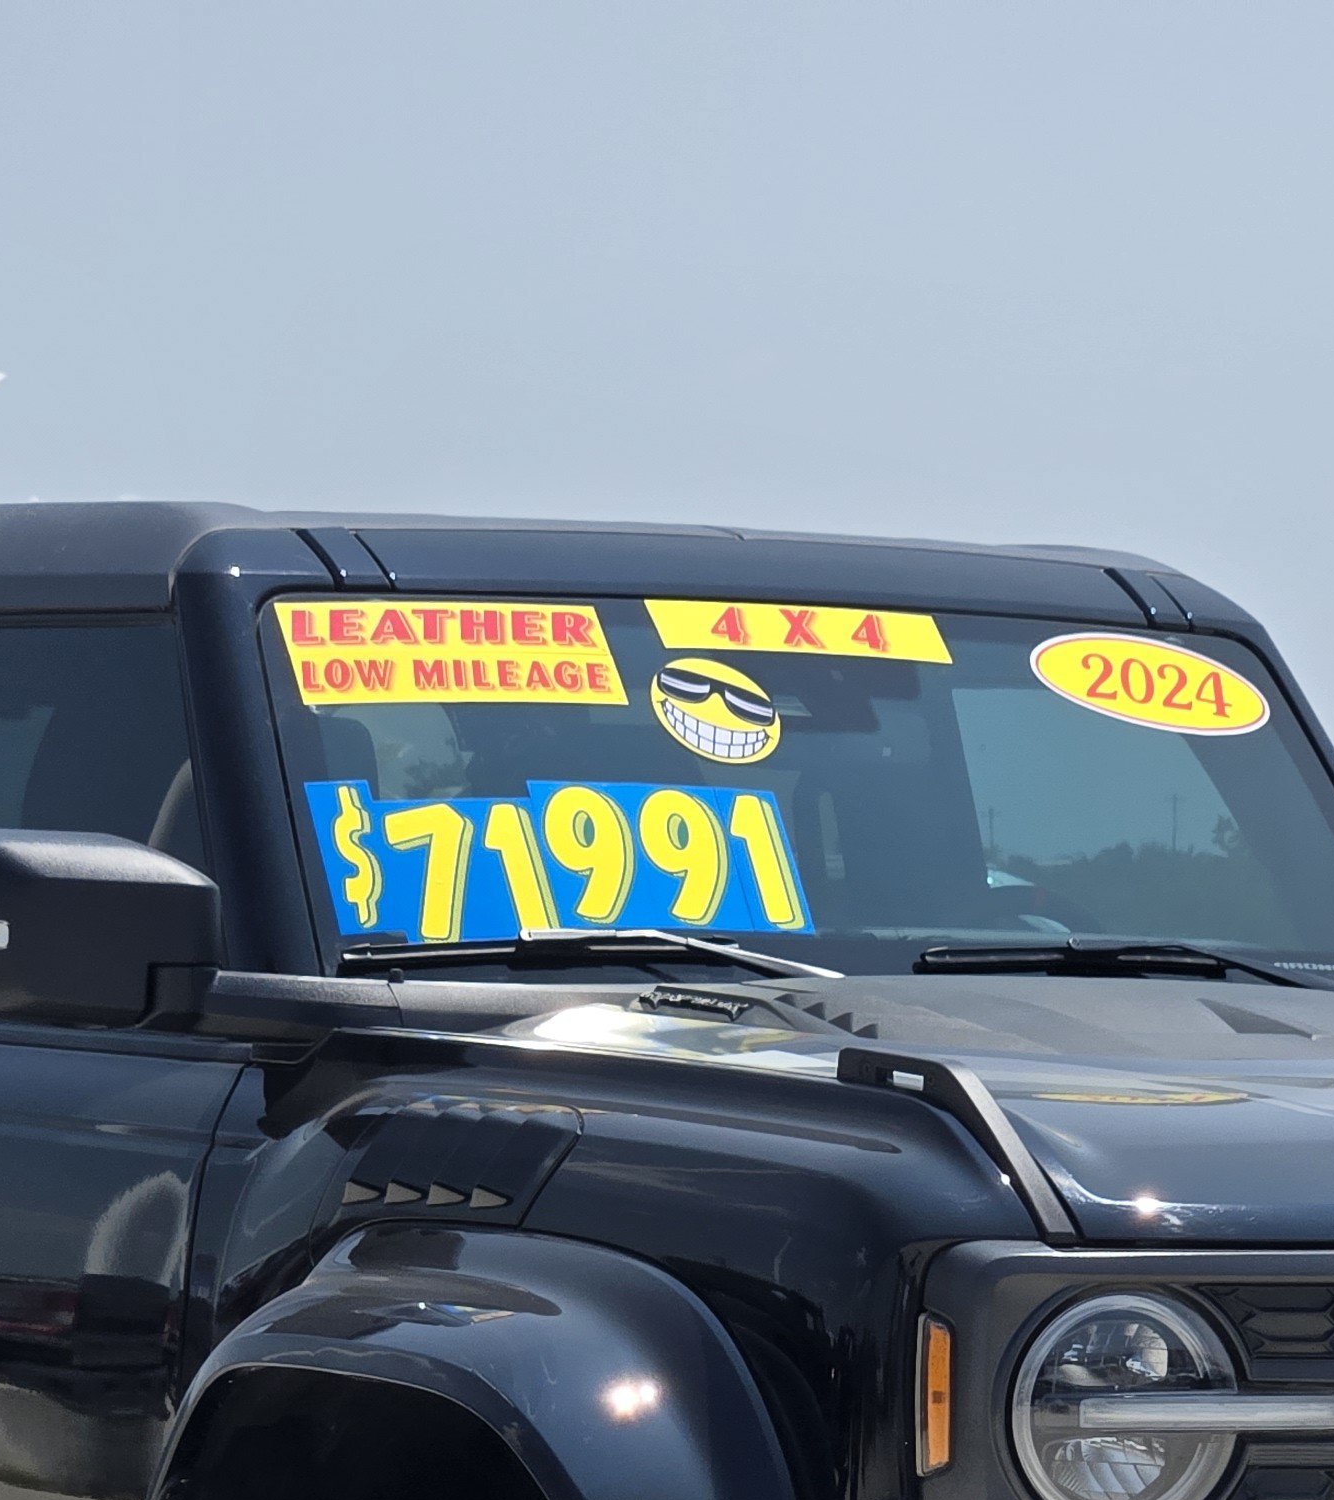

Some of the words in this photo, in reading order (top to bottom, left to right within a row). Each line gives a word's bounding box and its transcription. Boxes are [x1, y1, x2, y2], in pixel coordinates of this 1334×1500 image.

[291, 608, 601, 648] LEATHER
[711, 606, 749, 645] 4
[778, 607, 821, 647] X
[850, 613, 890, 652] 4
[300, 658, 397, 692] LOW
[412, 659, 613, 693] MILEAGE
[1080, 652, 1233, 719] 2024
[333, 784, 807, 942] $71991
